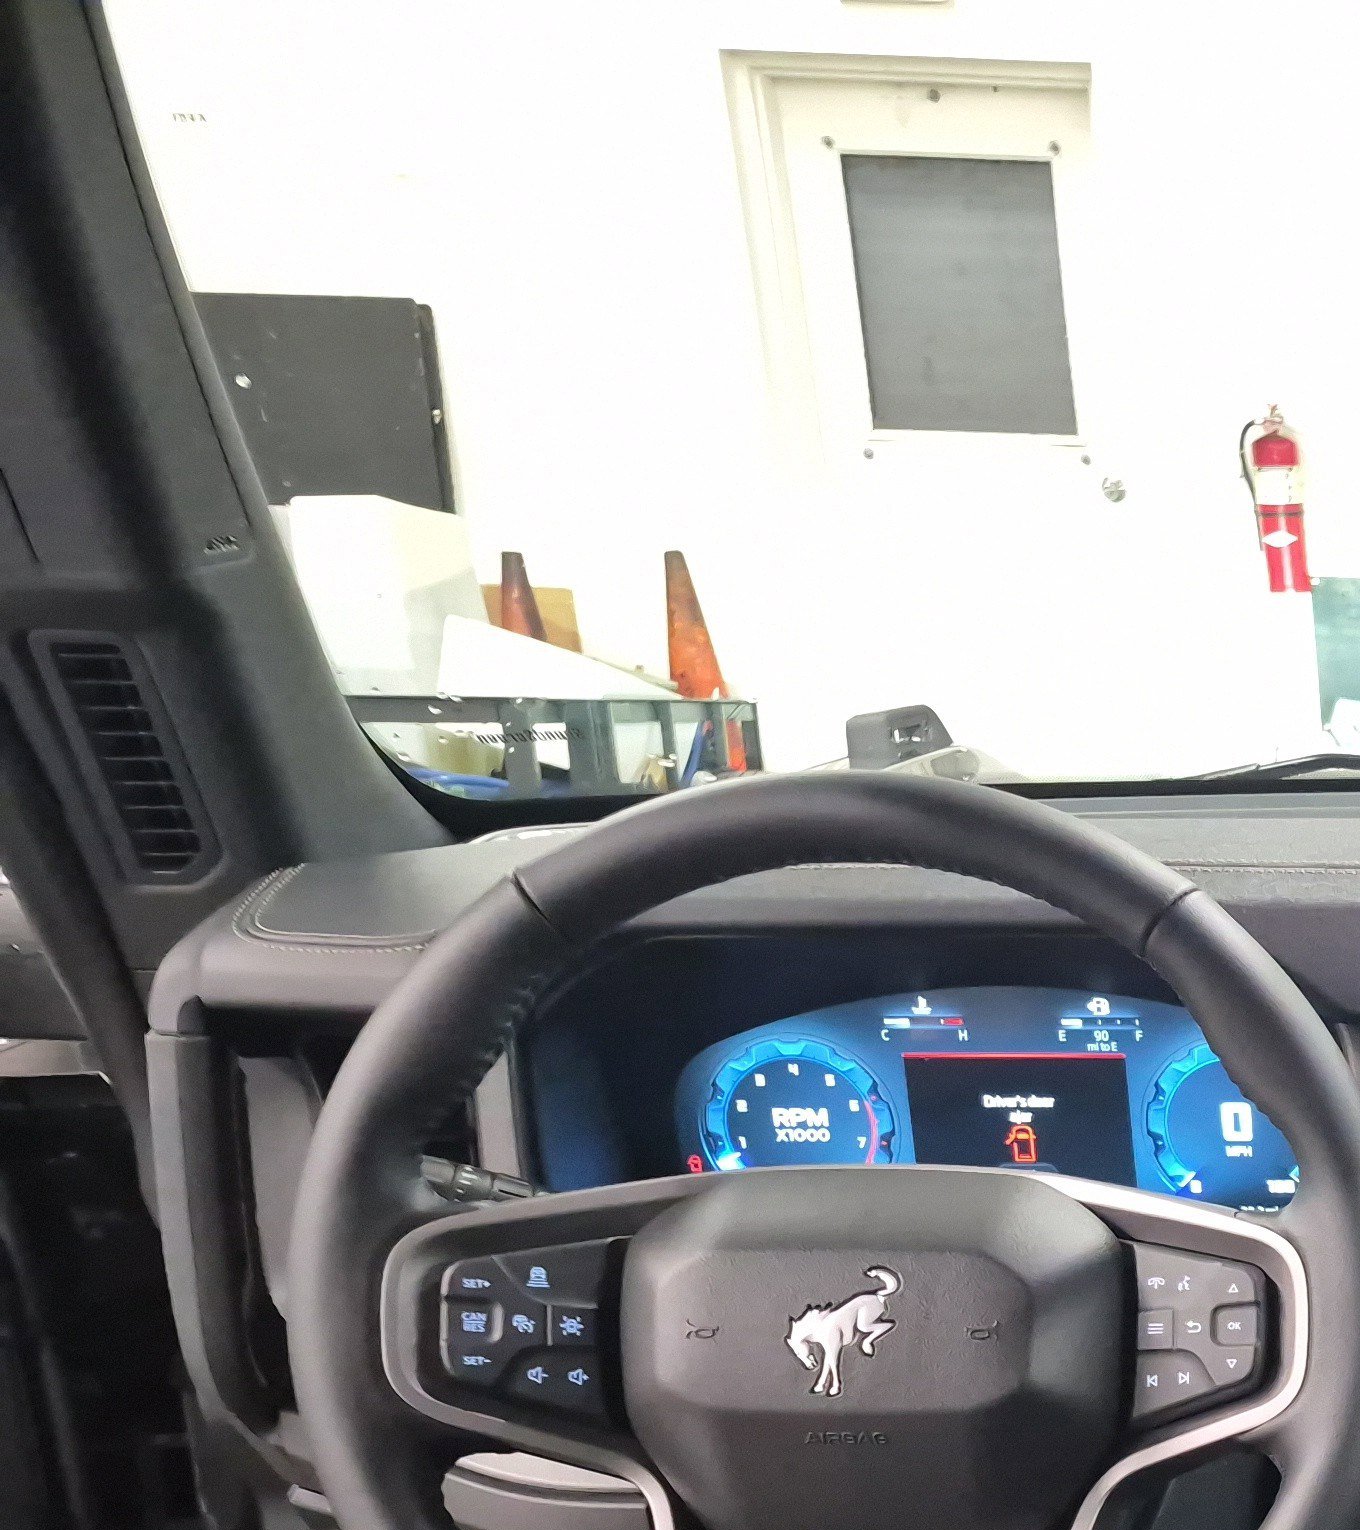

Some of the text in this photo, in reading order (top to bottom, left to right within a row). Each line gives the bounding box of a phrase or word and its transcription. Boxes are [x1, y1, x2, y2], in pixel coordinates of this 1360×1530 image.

[881, 1029, 890, 1041] C
[958, 1029, 969, 1041] H
[1058, 1030, 1066, 1042] E
[1093, 1030, 1110, 1042] 90
[1135, 1030, 1143, 1042] F
[771, 1107, 829, 1127] RPM
[1220, 1101, 1254, 1142] 0
[775, 1128, 831, 1143] X1000
[1227, 1321, 1242, 1331] OK
